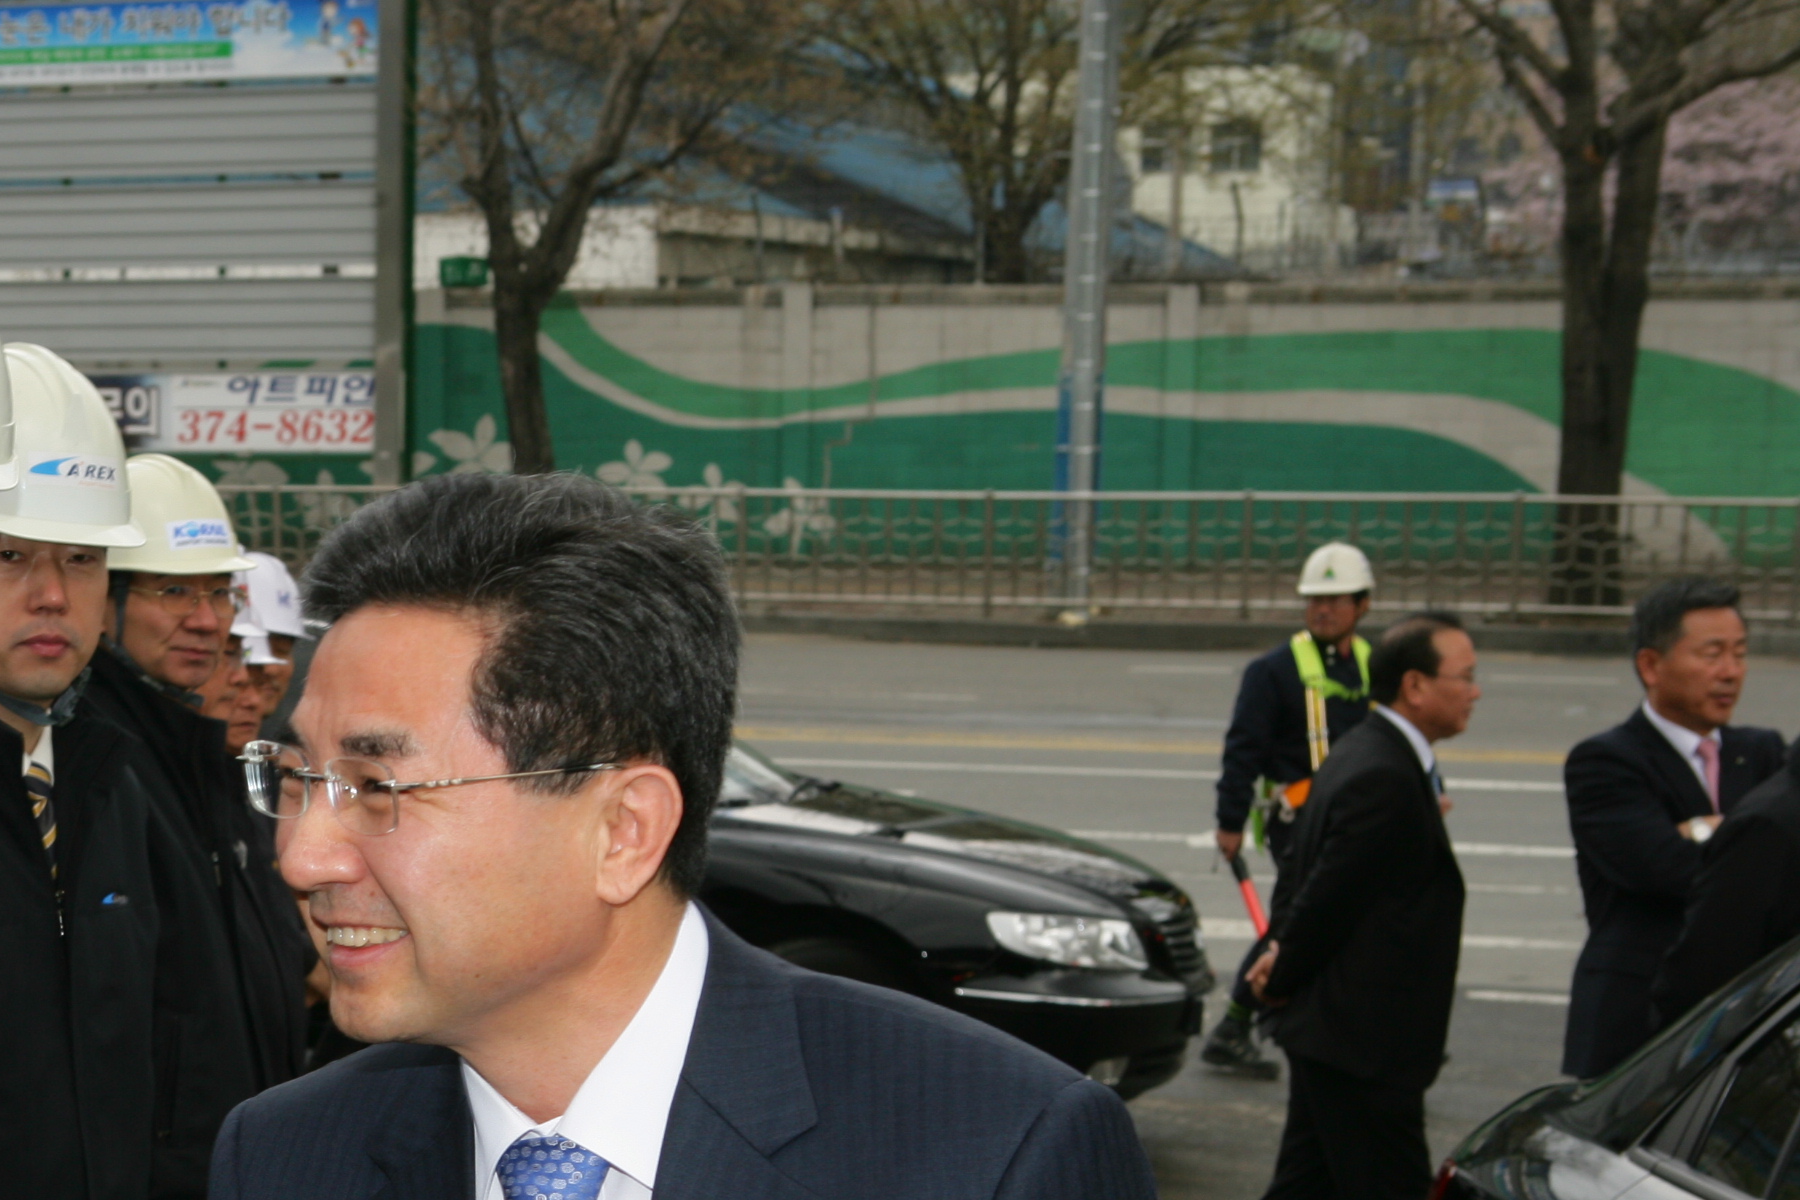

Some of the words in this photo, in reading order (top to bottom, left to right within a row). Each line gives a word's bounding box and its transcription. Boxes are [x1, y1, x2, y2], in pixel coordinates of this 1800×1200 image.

[58, 8, 114, 42] 내가
[206, 2, 292, 37] 합니다
[177, 408, 376, 443] 374-8632
